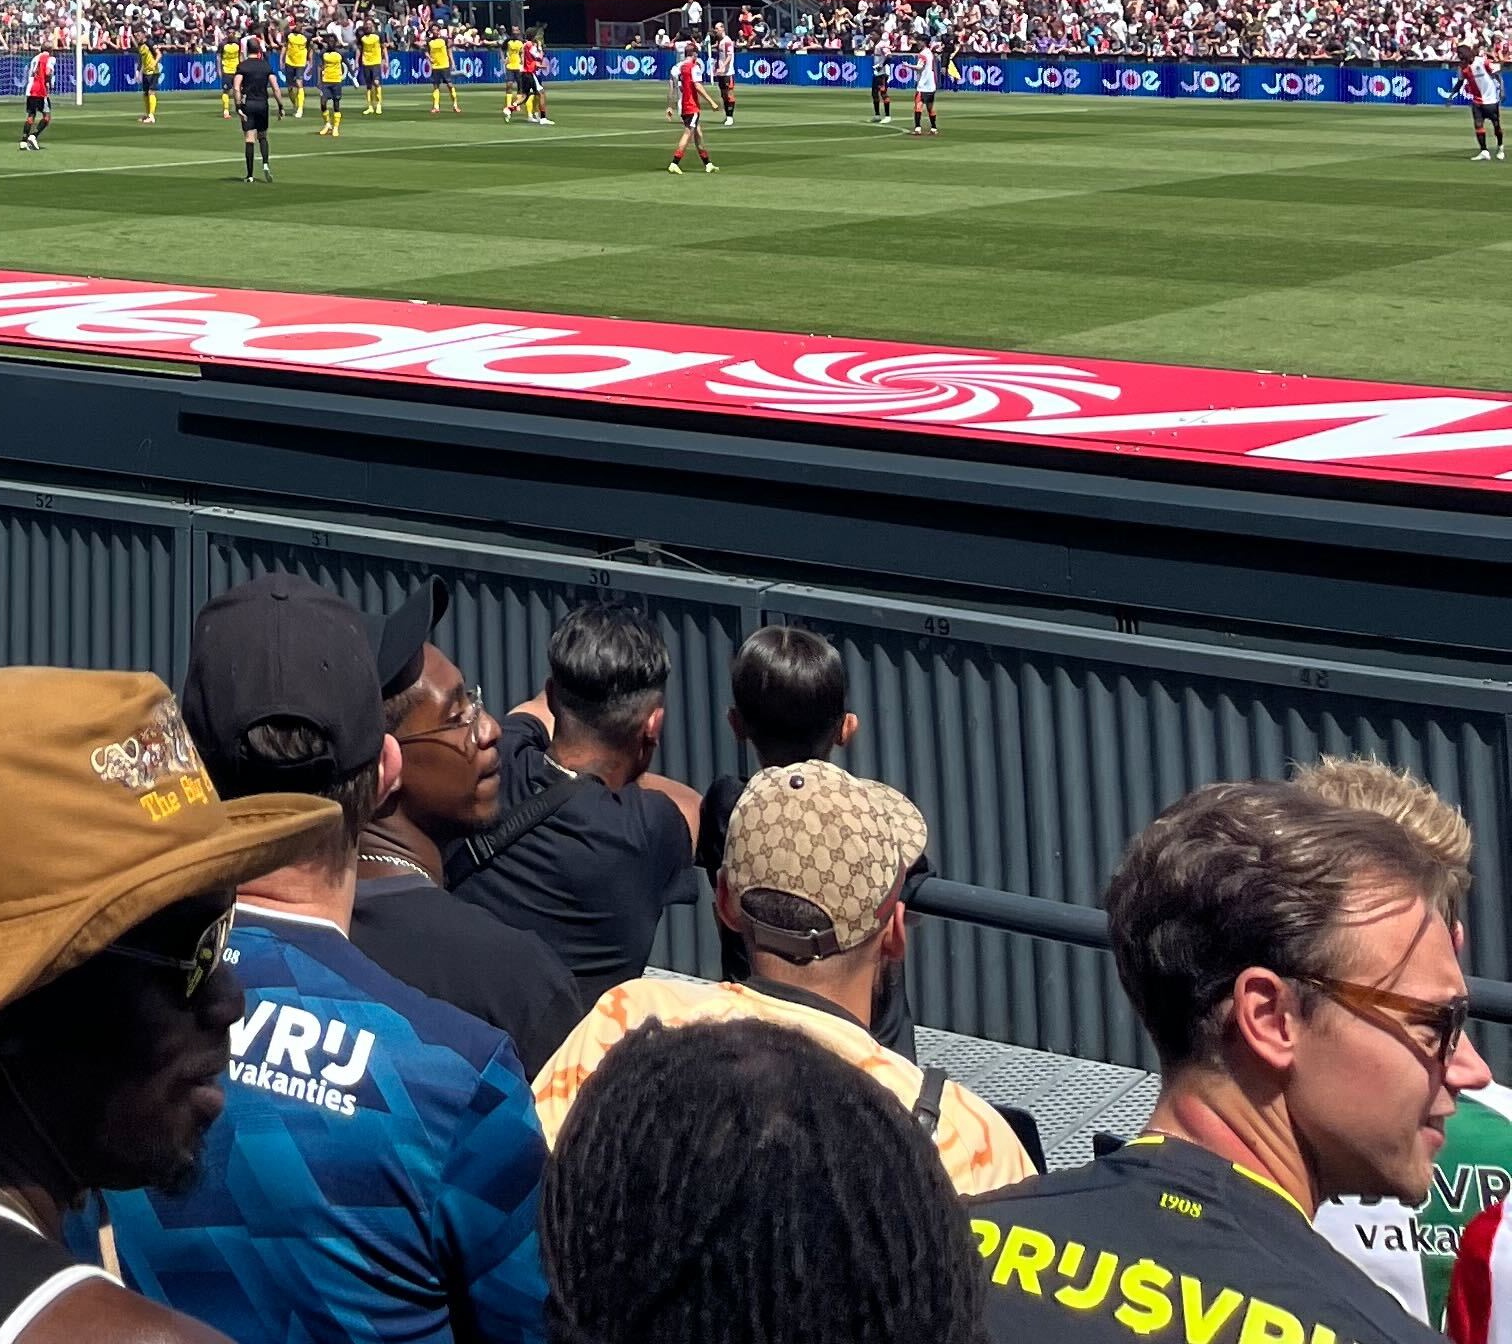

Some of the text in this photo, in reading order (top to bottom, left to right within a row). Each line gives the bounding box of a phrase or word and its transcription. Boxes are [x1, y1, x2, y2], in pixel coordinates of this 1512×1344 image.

[34, 493, 54, 509] 52
[589, 568, 610, 586] 50
[923, 615, 951, 636] 49
[139, 790, 182, 822] The
[229, 1058, 357, 1116] vakanties
[1159, 1192, 1203, 1219] 1908
[1354, 1217, 1465, 1258] vaka
